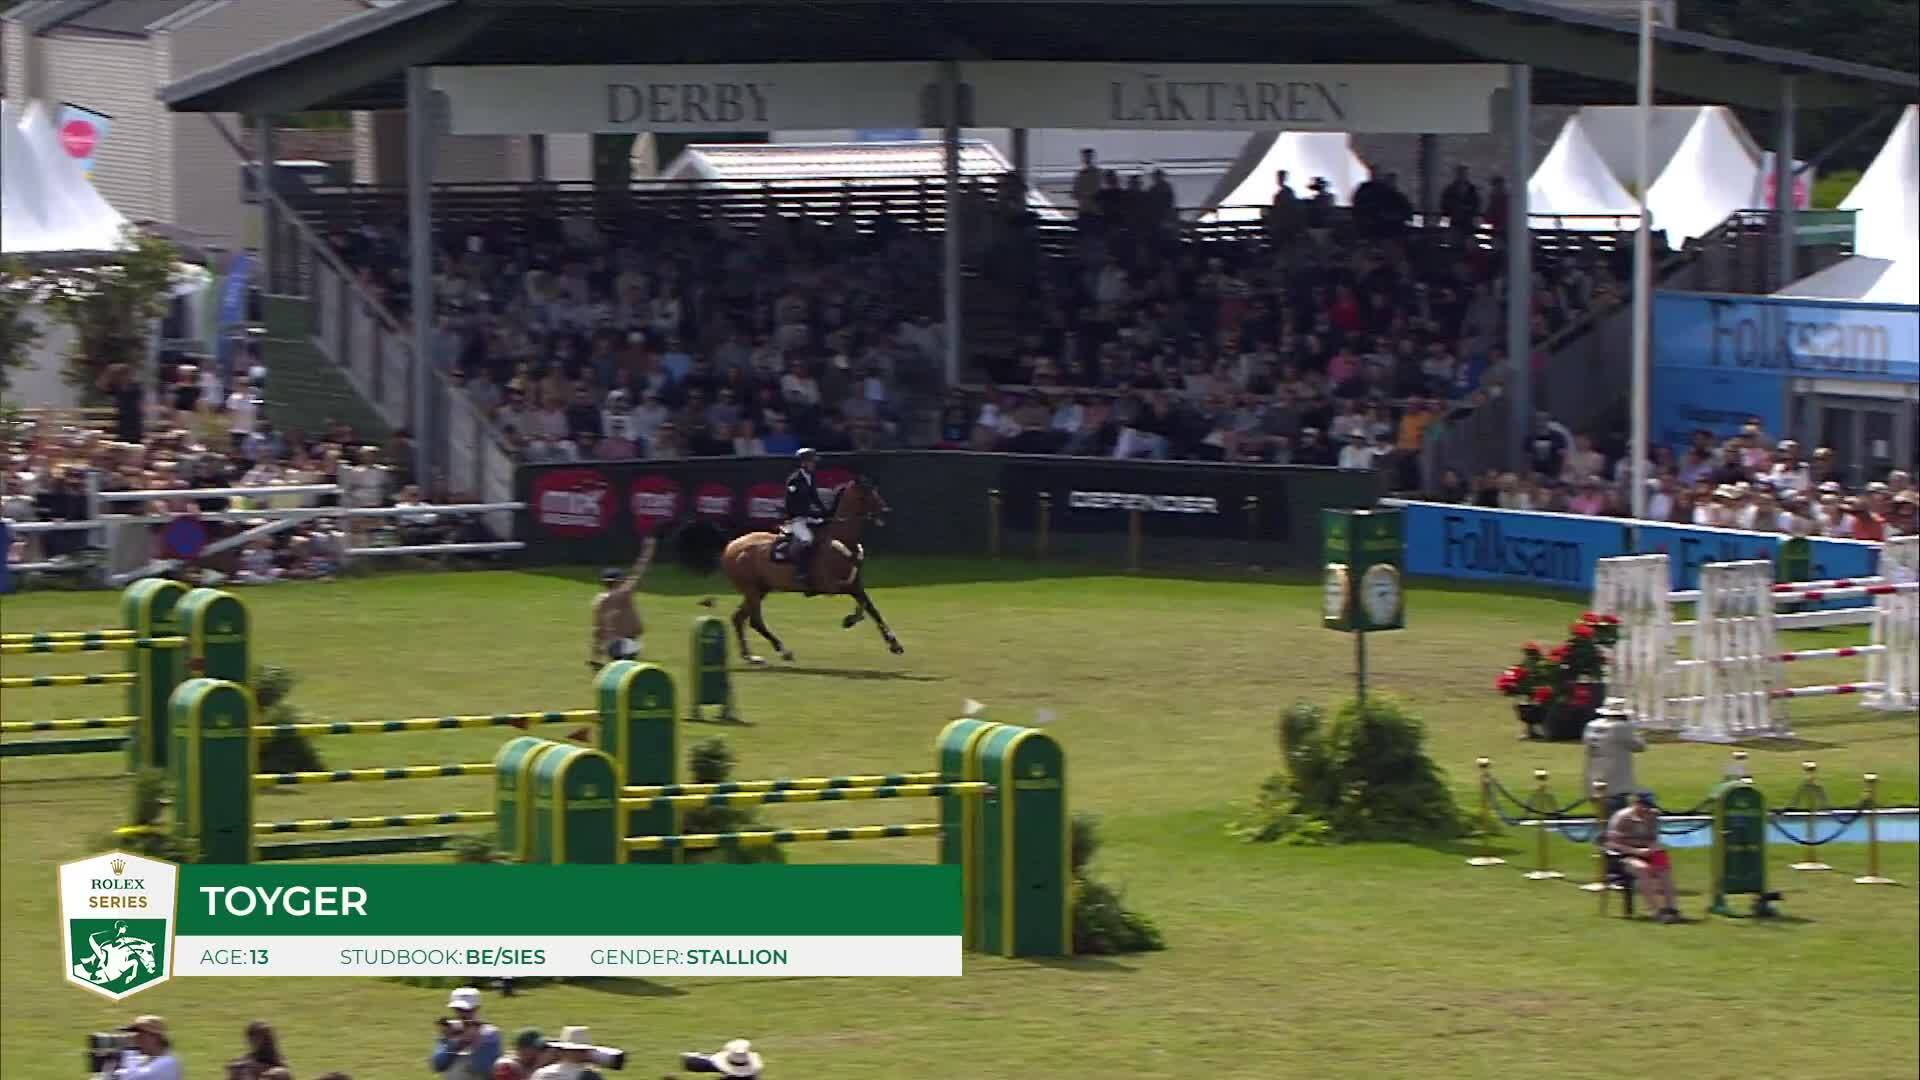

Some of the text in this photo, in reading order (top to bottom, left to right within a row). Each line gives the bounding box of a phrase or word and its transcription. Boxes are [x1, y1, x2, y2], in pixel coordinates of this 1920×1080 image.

[606, 73, 1349, 123] DERBY LÄKTAREN
[1709, 299, 1889, 374] Folksam
[1070, 490, 1220, 515] DEFENDER
[1442, 515, 1583, 582] Folksam
